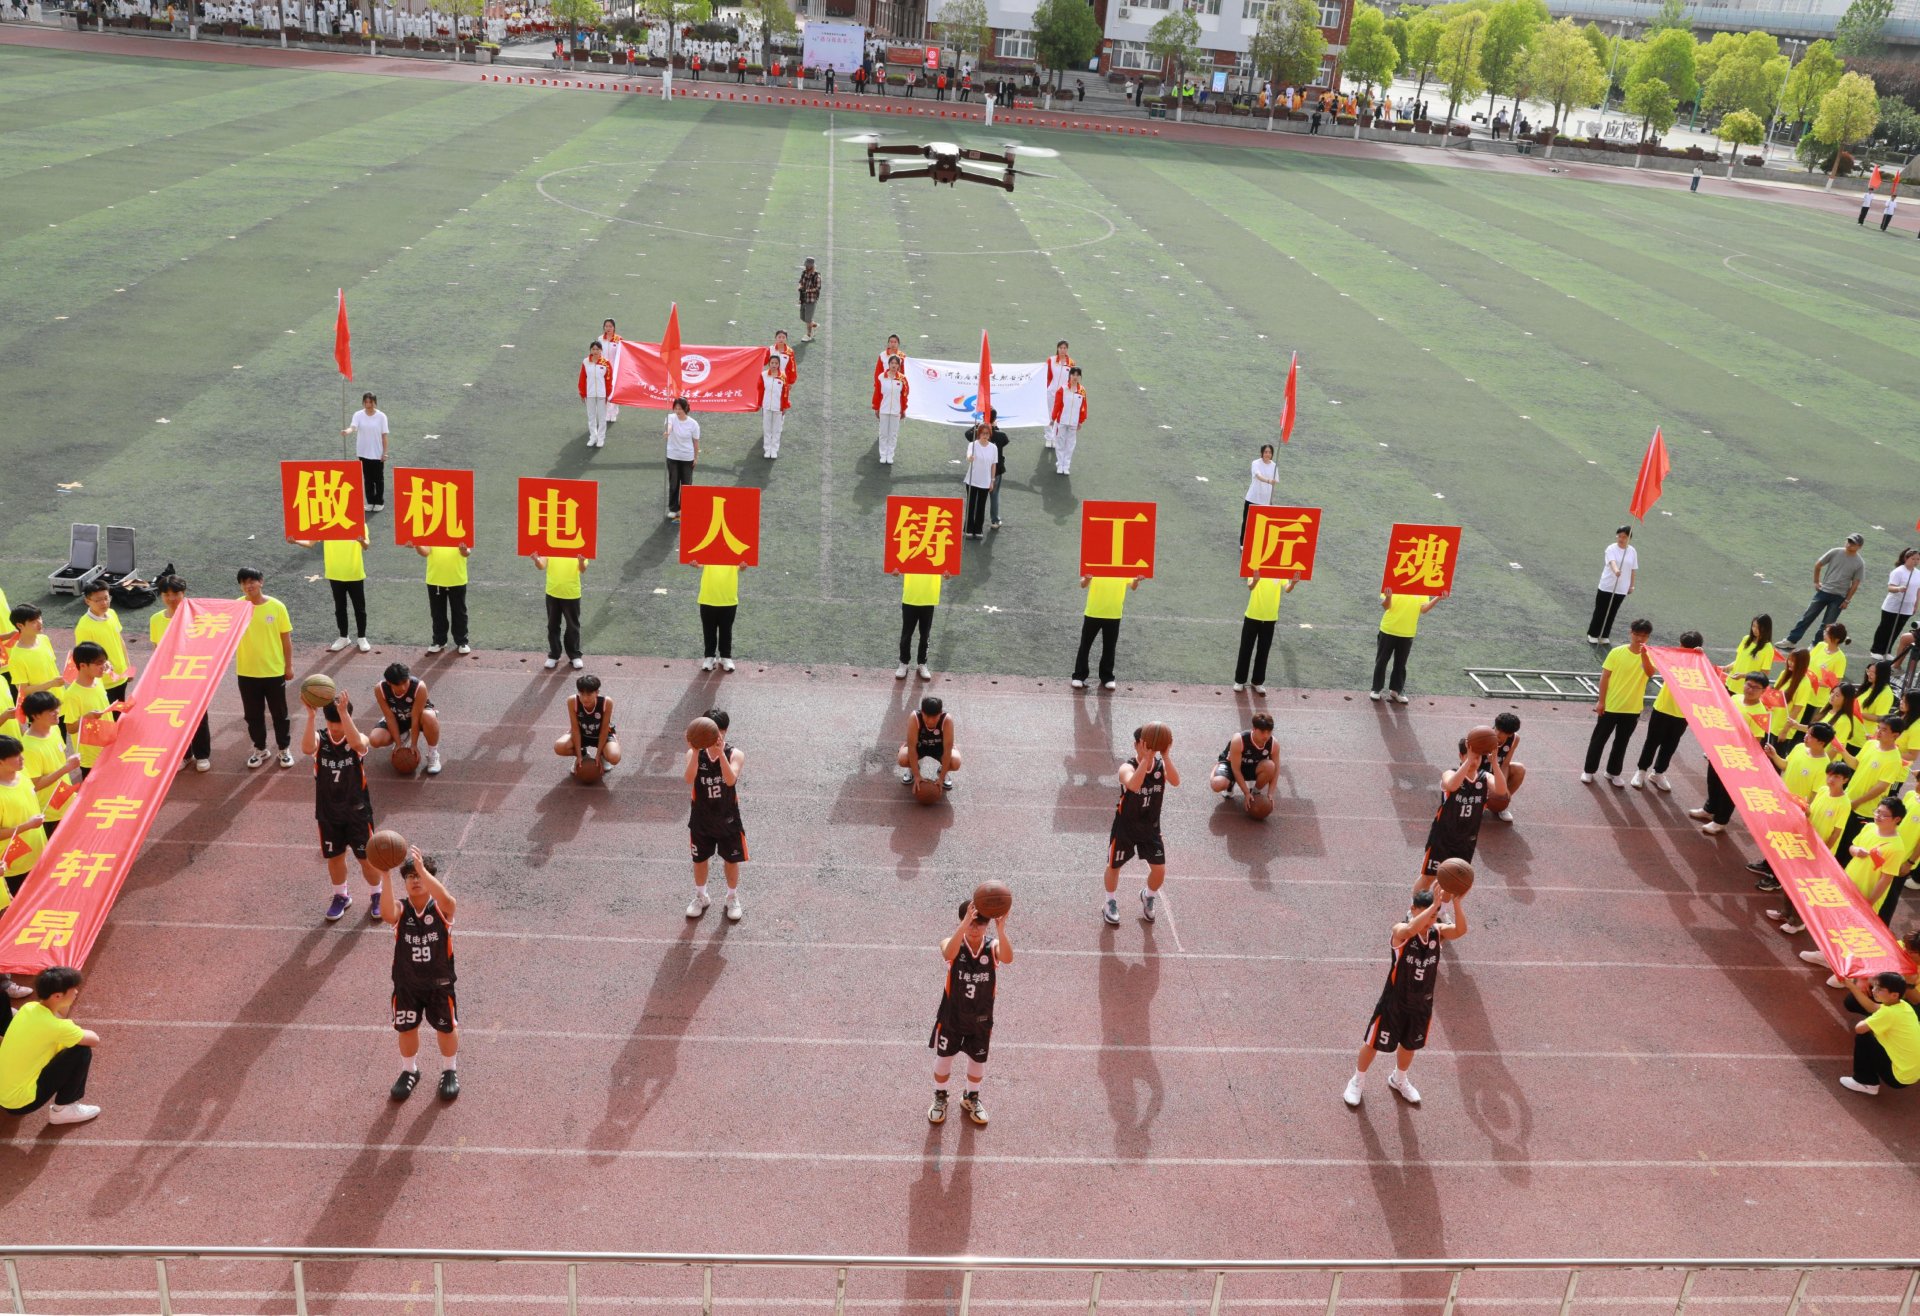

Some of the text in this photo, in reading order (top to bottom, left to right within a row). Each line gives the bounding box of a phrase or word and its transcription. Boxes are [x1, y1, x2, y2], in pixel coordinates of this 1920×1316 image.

[293, 470, 357, 531] 做
[402, 476, 466, 538] 机
[528, 488, 586, 549] 电
[688, 496, 750, 555] 人
[893, 505, 954, 567] 铸
[1085, 512, 1149, 569] 工
[1248, 513, 1312, 571] 匠
[1393, 534, 1449, 588] 魂
[332, 770, 341, 783] 7
[708, 785, 722, 799] 12
[1460, 804, 1473, 818] 13
[325, 841, 333, 852] 7
[411, 946, 432, 962] 29
[1414, 968, 1425, 981] 5
[965, 984, 976, 999] 3
[395, 1010, 417, 1025] 29
[938, 1035, 949, 1051] 3
[1379, 1030, 1390, 1045] 5
